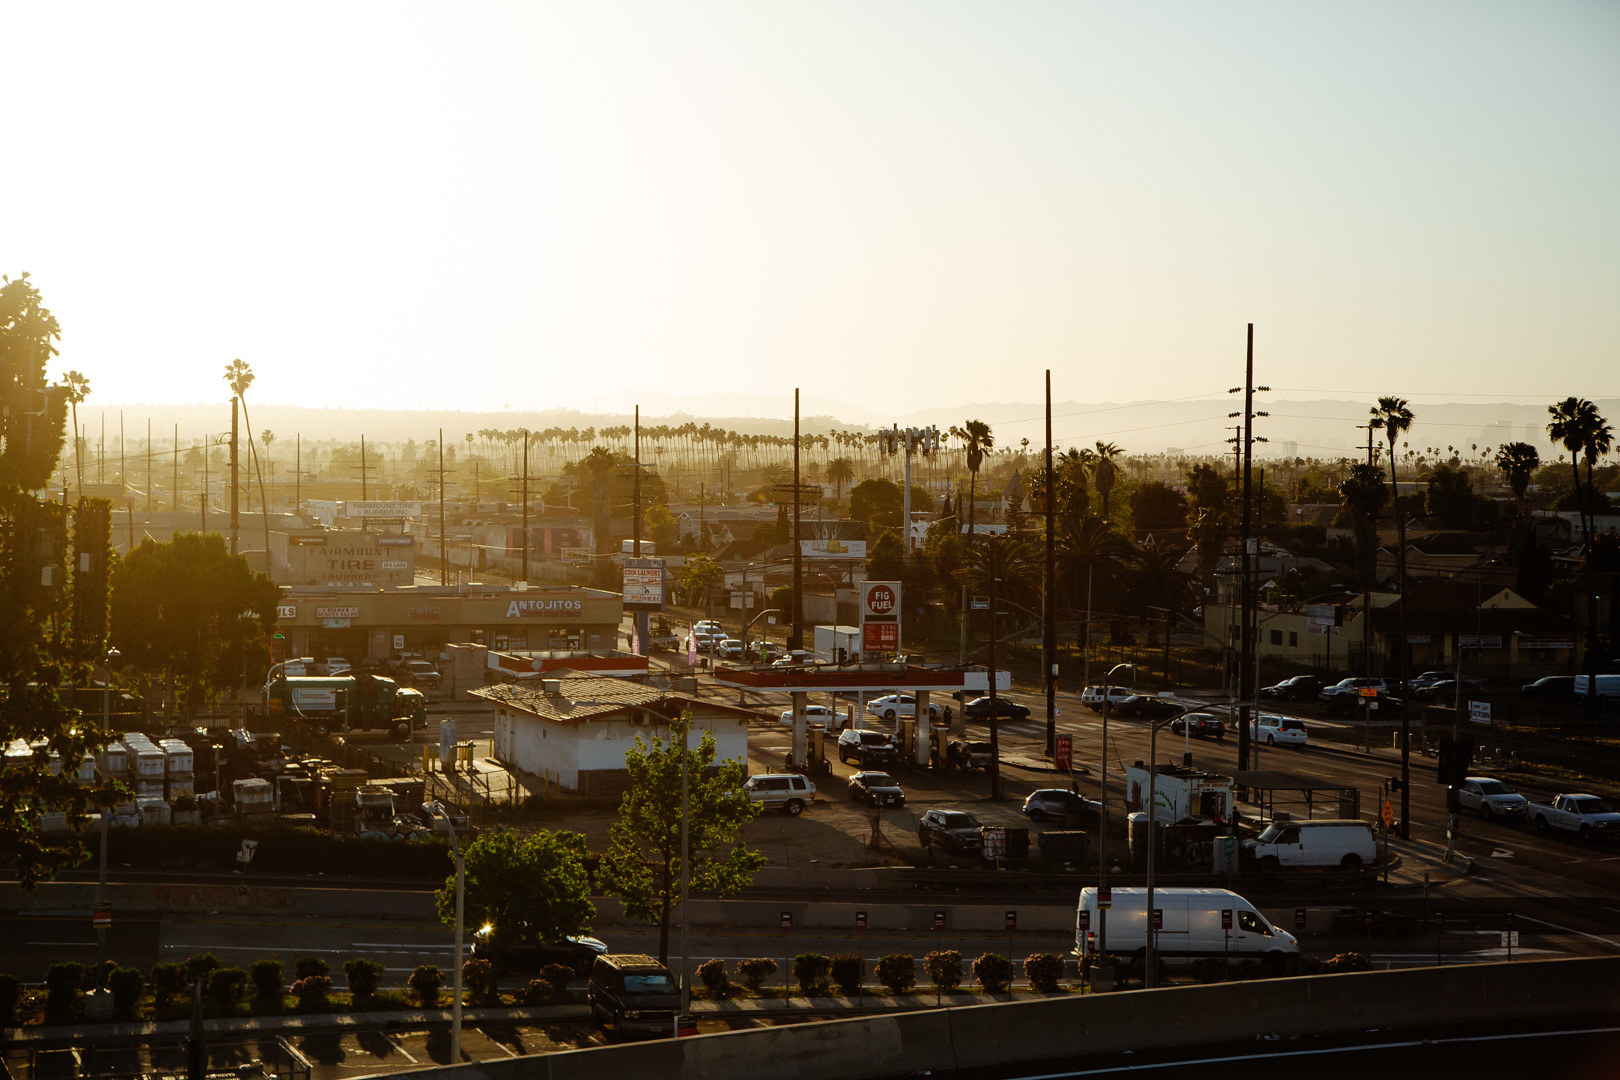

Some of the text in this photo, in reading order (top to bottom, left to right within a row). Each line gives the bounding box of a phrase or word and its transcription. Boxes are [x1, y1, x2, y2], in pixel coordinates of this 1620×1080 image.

[310, 548, 390, 556] FAIRMOUNT
[327, 559, 375, 570] TIRE
[637, 569, 661, 577] LAUNDRY
[875, 591, 890, 600] FIG
[506, 600, 582, 617] ANTOJITOS
[871, 601, 893, 610] FUEL
